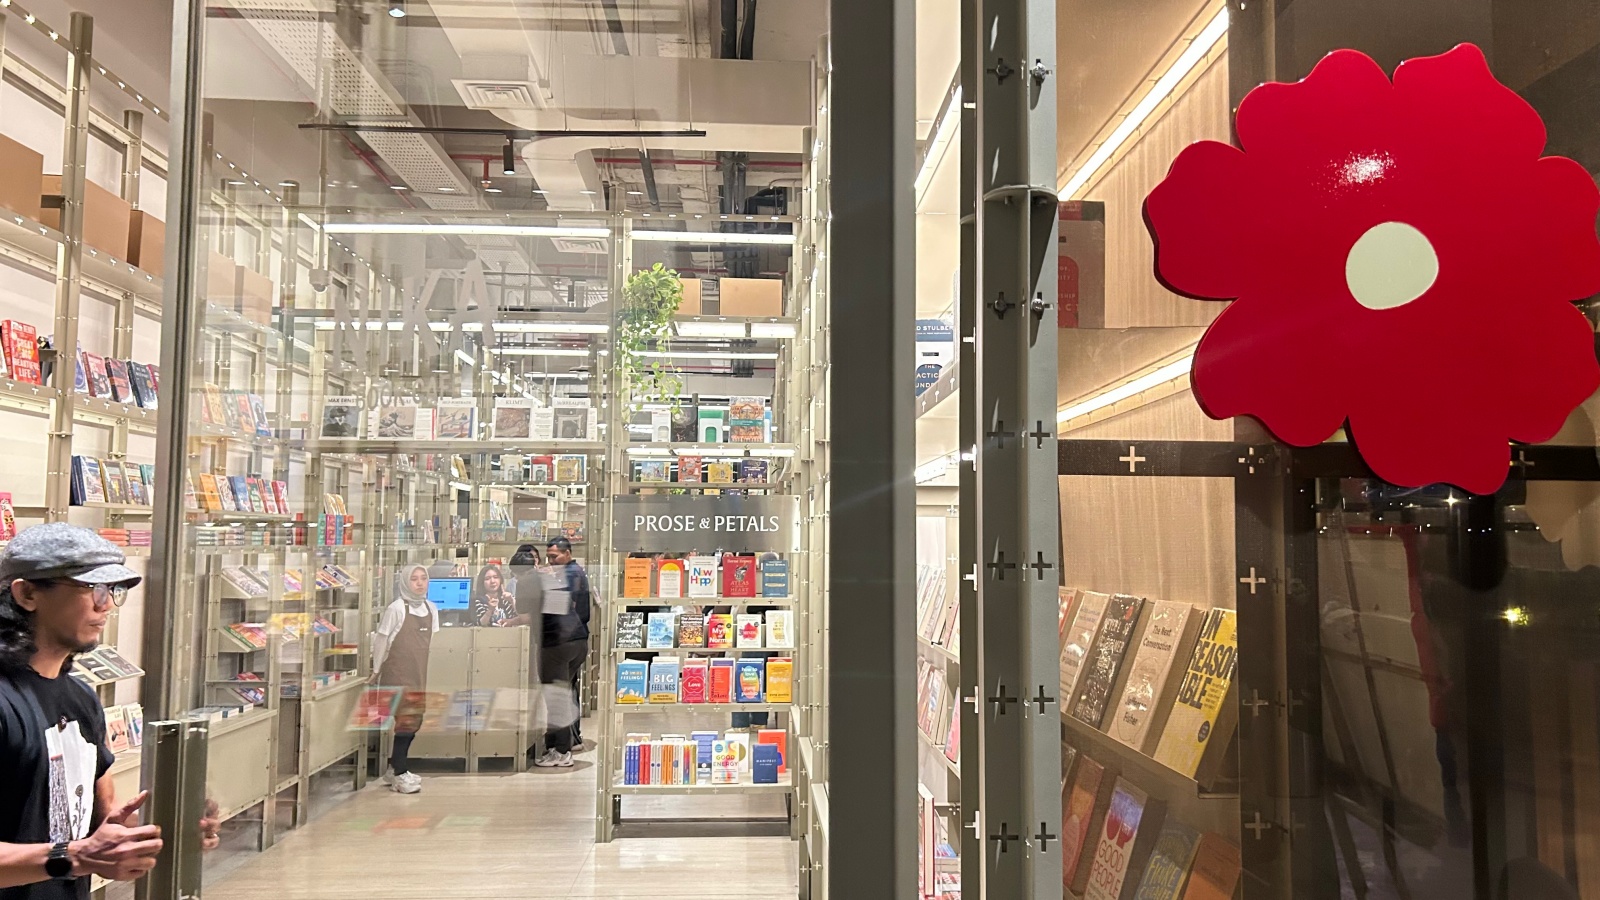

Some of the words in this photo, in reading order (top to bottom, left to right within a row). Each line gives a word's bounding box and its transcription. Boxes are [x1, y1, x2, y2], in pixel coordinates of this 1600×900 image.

[634, 515, 695, 532] PROSE
[699, 517, 711, 529] &
[714, 515, 780, 532] PETALS
[651, 683, 676, 691] FEELINGS
[653, 674, 675, 684] BIG
[1098, 839, 1124, 873] GOOD
[1091, 859, 1121, 900] PEOPLE
